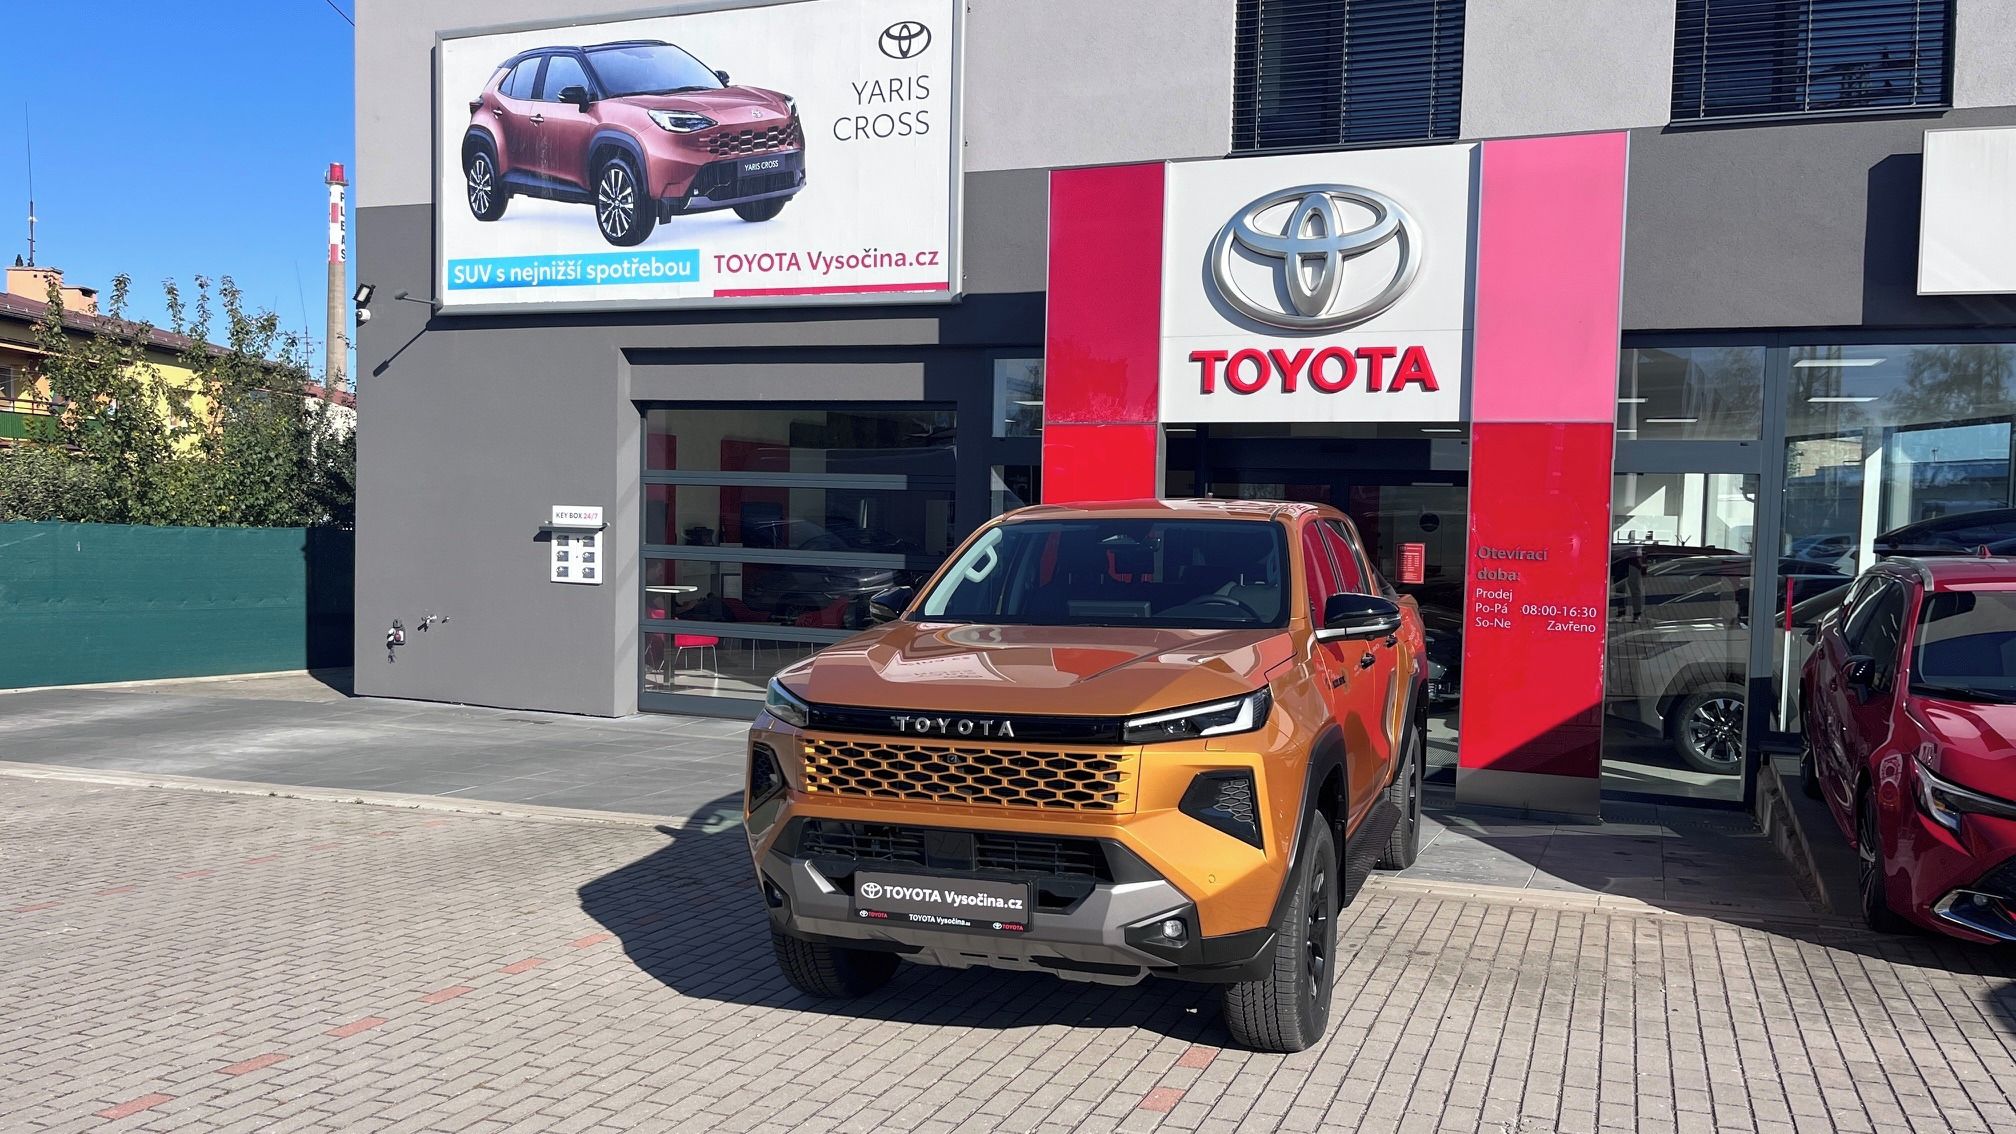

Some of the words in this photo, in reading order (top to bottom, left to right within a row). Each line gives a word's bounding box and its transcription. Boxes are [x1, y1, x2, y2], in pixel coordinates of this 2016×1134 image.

[852, 75, 930, 105] YARIS
[833, 110, 930, 141] CROSS
[744, 162, 760, 171] YARIS
[761, 160, 779, 169] CROSS
[454, 264, 492, 284] SUV
[496, 268, 505, 282] s
[510, 260, 583, 285] nejnižší
[586, 256, 691, 283] spotřebou
[714, 252, 801, 273] TOYOTA
[807, 248, 939, 275] Vysočina.cz
[1190, 345, 1440, 394] TOYOTA
[1477, 546, 1549, 561] Otevírací
[1476, 588, 1513, 602] Prodej
[1475, 602, 1508, 614] Po-Pá
[1521, 604, 1597, 618] 08:00-16:30
[1475, 617, 1511, 629] So-Ne
[1546, 620, 1596, 633] Zavřeno
[896, 715, 1015, 737] TOYOTA
[884, 885, 942, 903] TOYOTA
[944, 890, 1023, 910] Vysočina.cz
[868, 911, 888, 919] TOYOTA
[909, 913, 935, 923] TOYOTA
